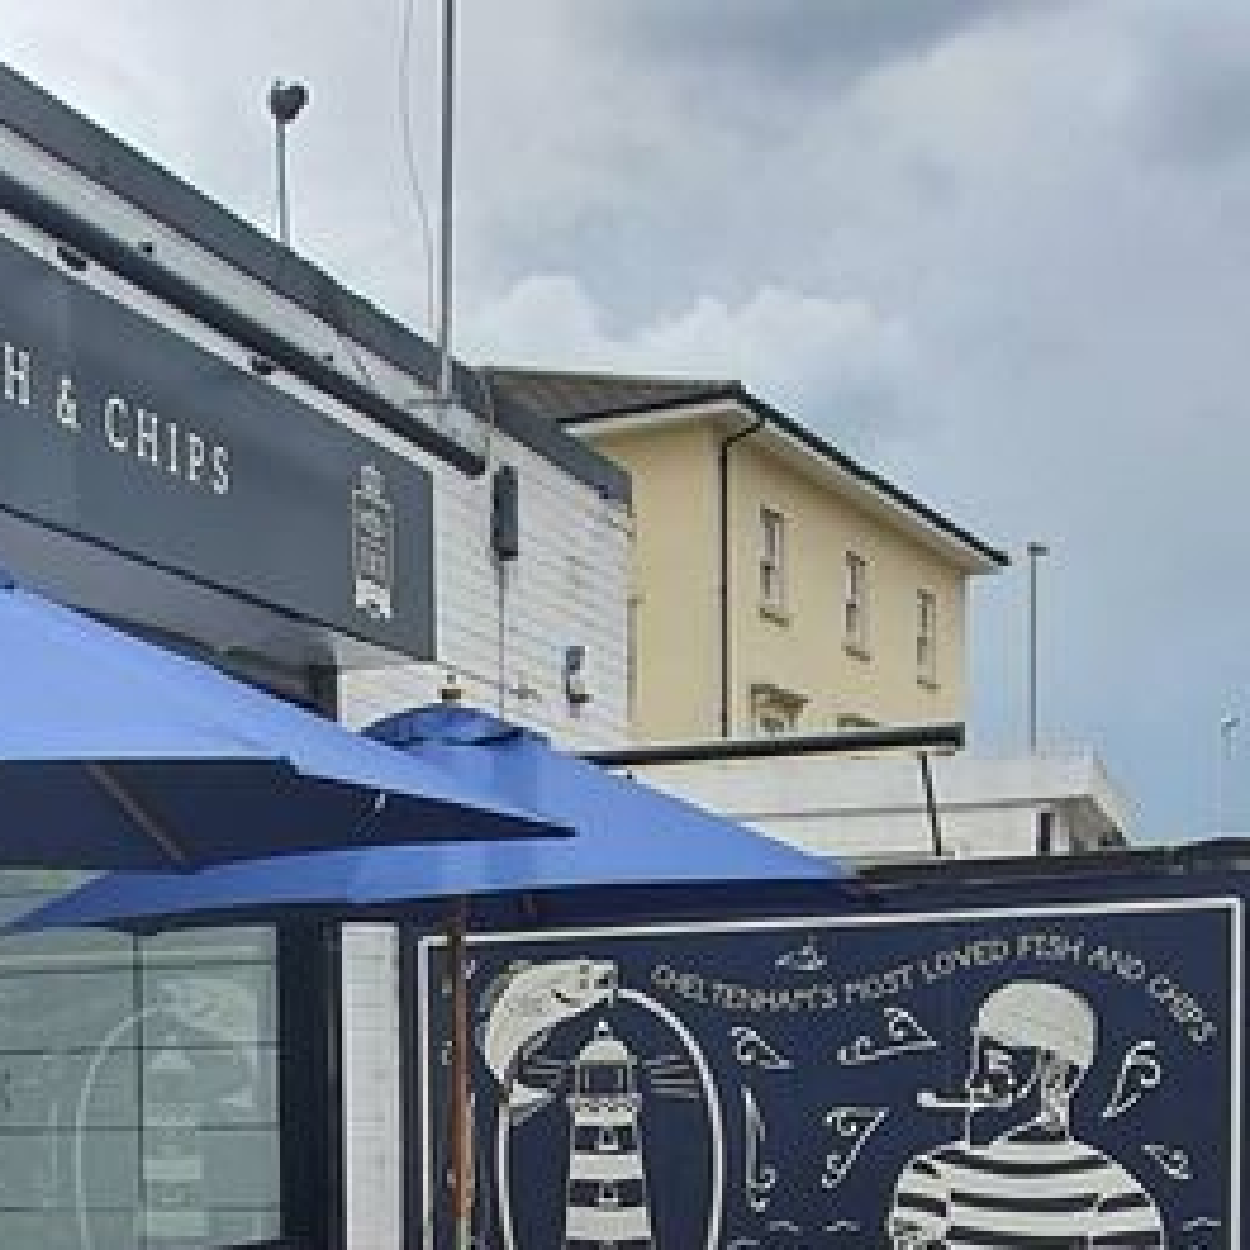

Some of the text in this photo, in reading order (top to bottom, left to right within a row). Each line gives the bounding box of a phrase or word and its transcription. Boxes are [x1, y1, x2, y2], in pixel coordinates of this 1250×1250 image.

[57, 377, 82, 430] &
[105, 398, 231, 495] CHIPS
[846, 964, 915, 1004] MOST
[921, 941, 1008, 984] LOVED
[1017, 934, 1083, 962] FISH
[1088, 944, 1145, 981] AND
[1150, 976, 1217, 1043] CHIPS
